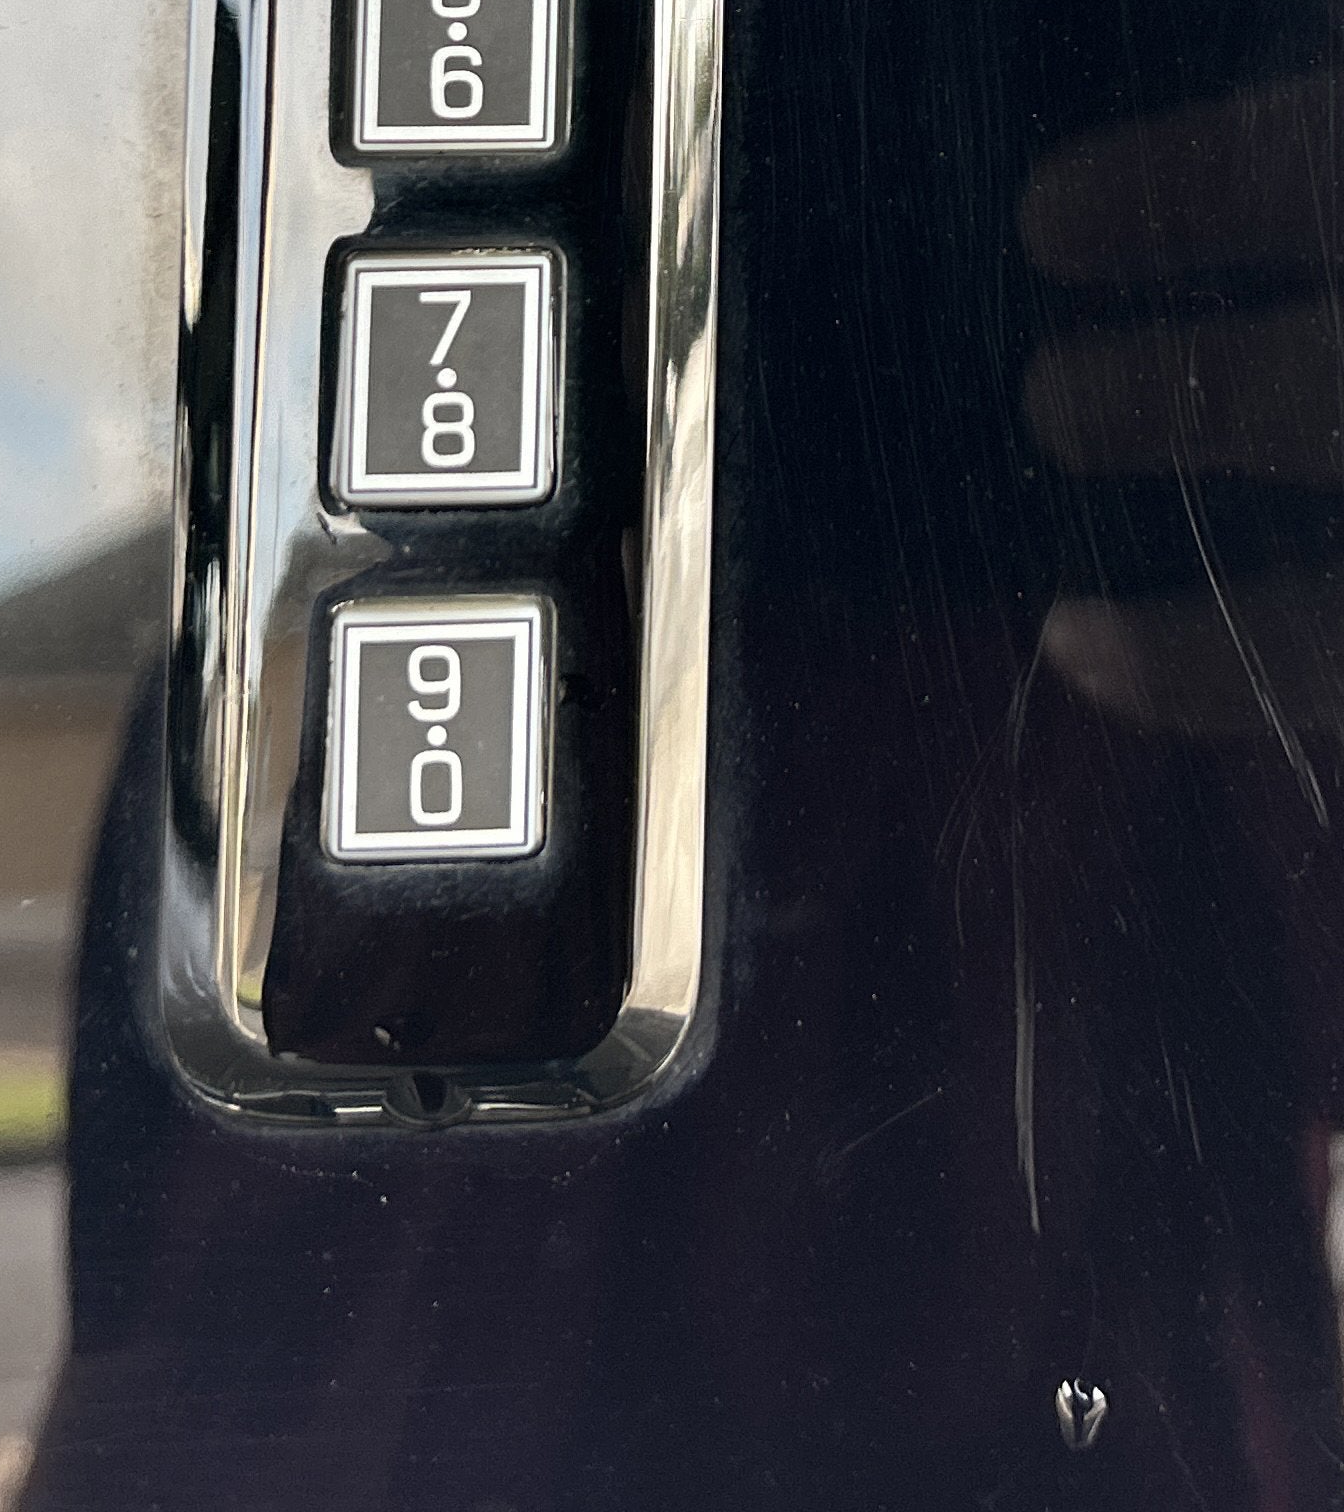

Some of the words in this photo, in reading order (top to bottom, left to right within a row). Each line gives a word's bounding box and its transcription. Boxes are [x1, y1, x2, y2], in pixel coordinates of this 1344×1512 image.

[429, 45, 484, 120] 6
[418, 289, 472, 367] 7
[420, 391, 476, 469] 8
[406, 644, 462, 724] 9
[409, 749, 463, 827] 0
